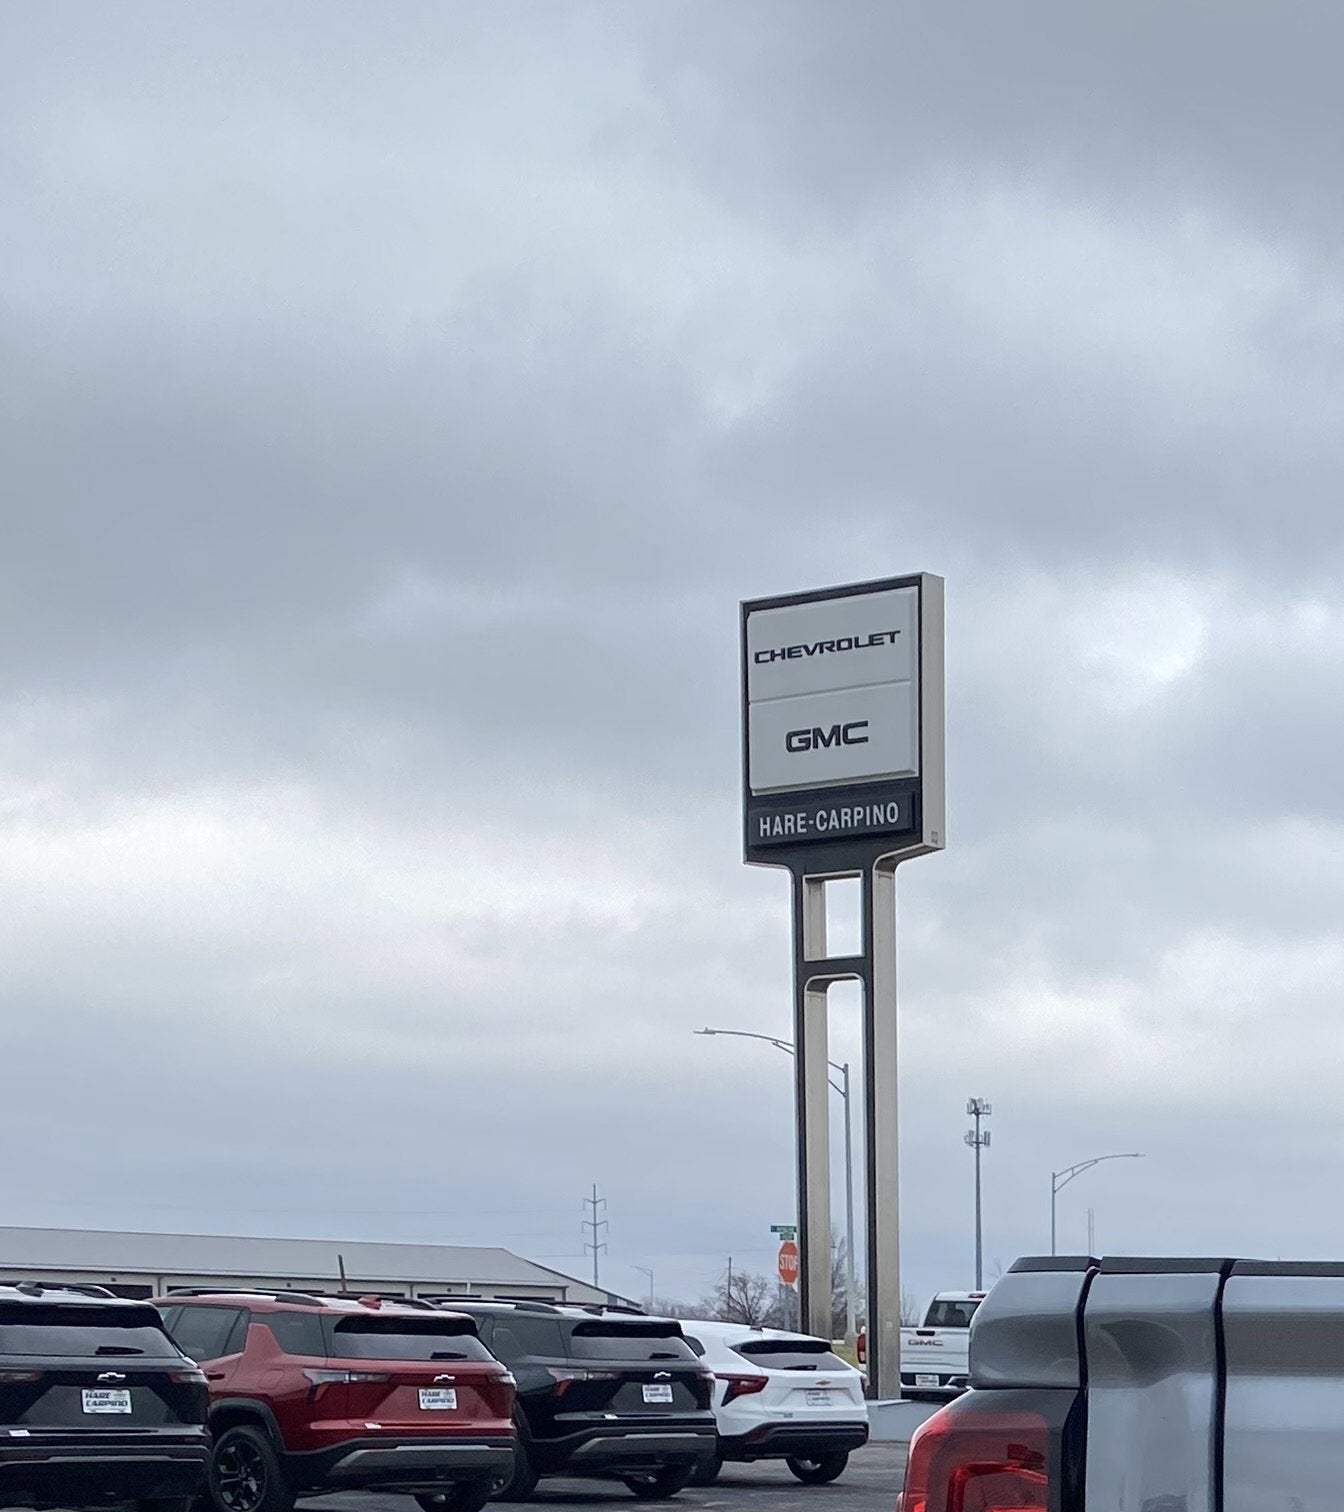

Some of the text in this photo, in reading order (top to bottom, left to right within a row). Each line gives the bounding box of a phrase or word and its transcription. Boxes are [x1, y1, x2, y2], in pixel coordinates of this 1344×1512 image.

[754, 630, 901, 664] CHEVROLET
[785, 720, 869, 753] GMC
[759, 801, 899, 837] HARE-CARPINO
[908, 1339, 944, 1347] GMC
